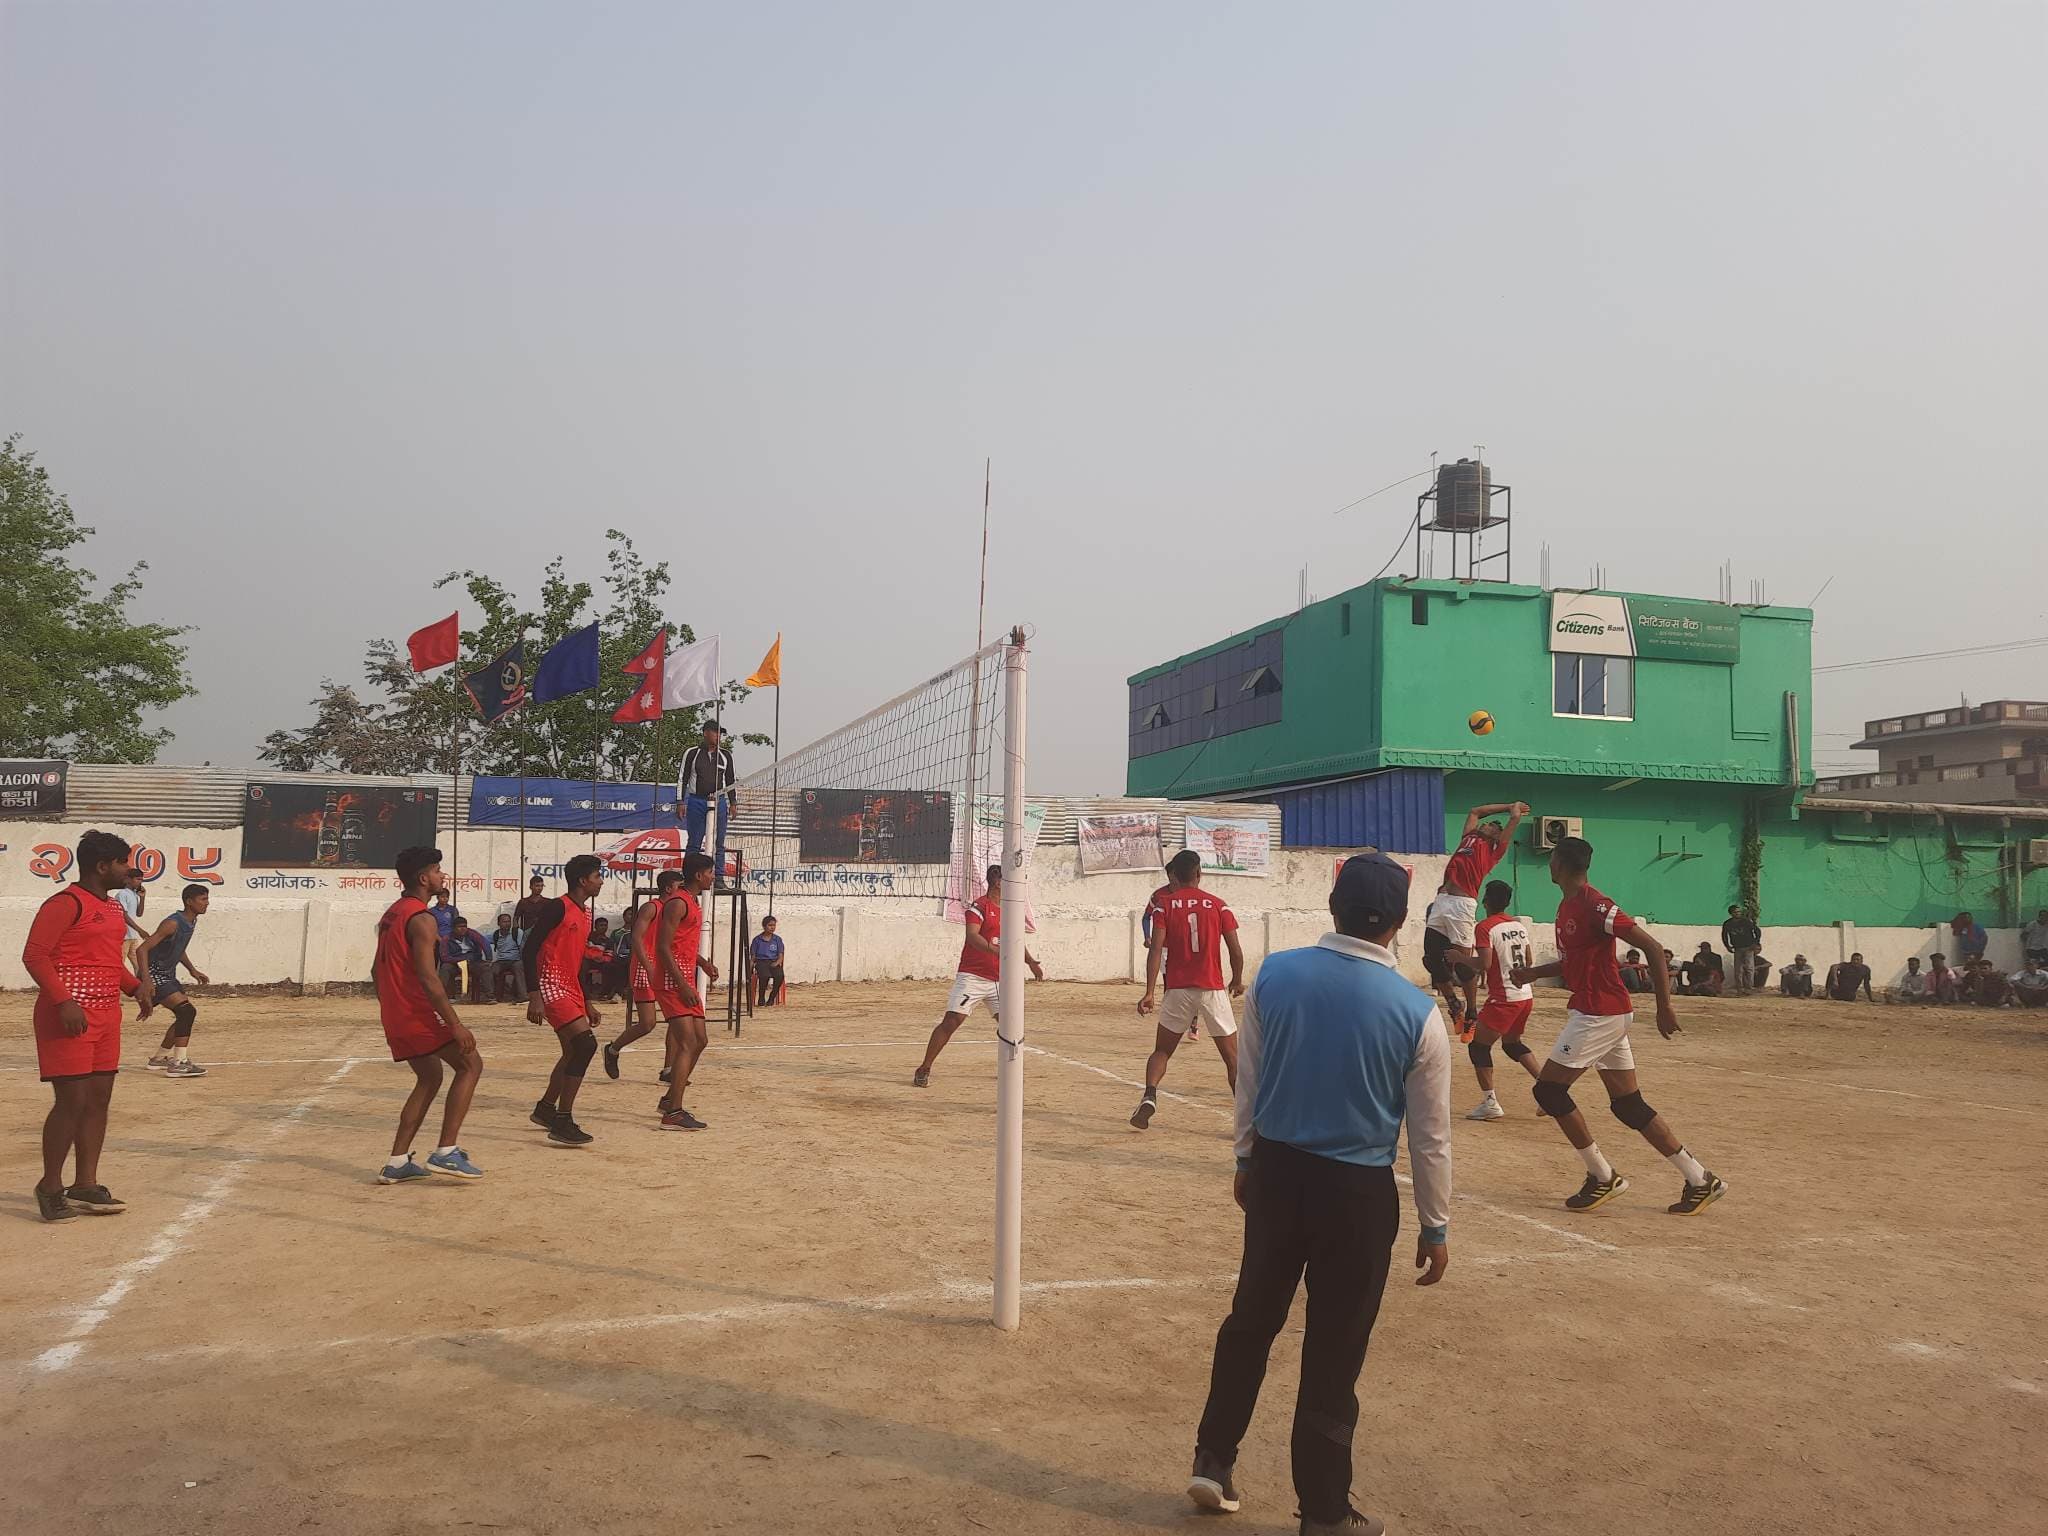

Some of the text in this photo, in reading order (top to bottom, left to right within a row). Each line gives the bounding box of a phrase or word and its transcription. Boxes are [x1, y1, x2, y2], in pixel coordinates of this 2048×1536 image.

[1556, 620, 1625, 635] Citizens Bank
[1171, 899, 1213, 909] NPC
[1187, 912, 1200, 953] 1
[1501, 930, 1526, 942] NPC
[1511, 944, 1524, 969] 5
[960, 993, 969, 1007] 7
